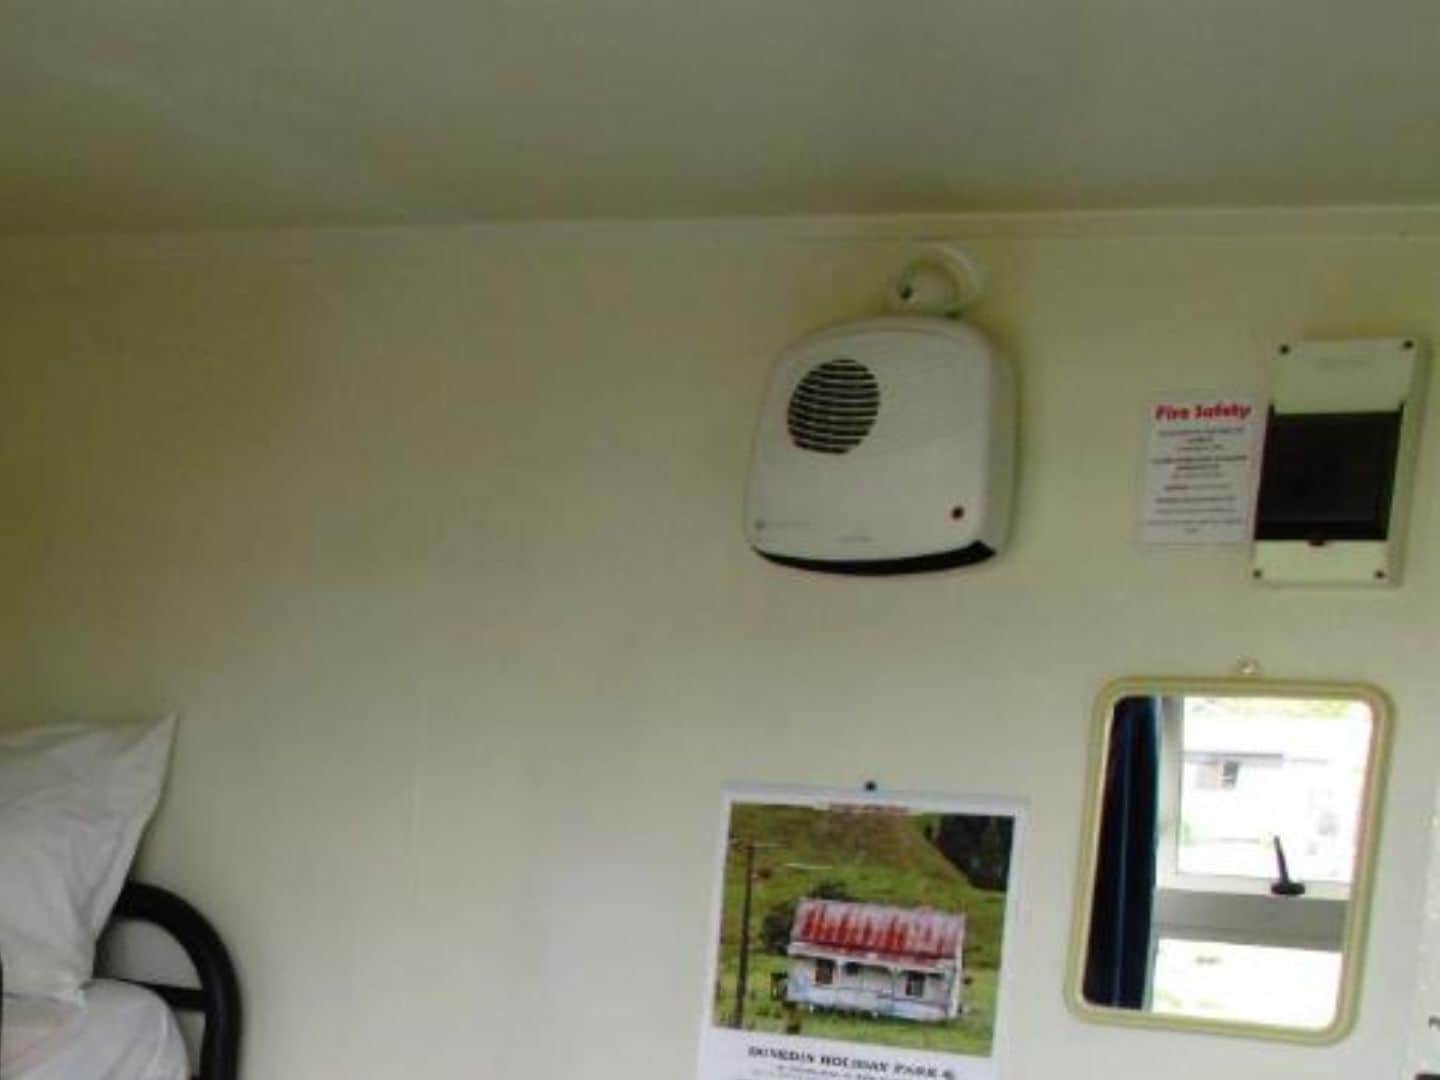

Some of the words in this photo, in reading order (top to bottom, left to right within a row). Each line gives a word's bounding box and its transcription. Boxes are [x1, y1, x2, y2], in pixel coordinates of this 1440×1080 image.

[1155, 404, 1190, 421] Fire
[1194, 402, 1252, 421] Safety
[894, 1063, 938, 1079] PARK
